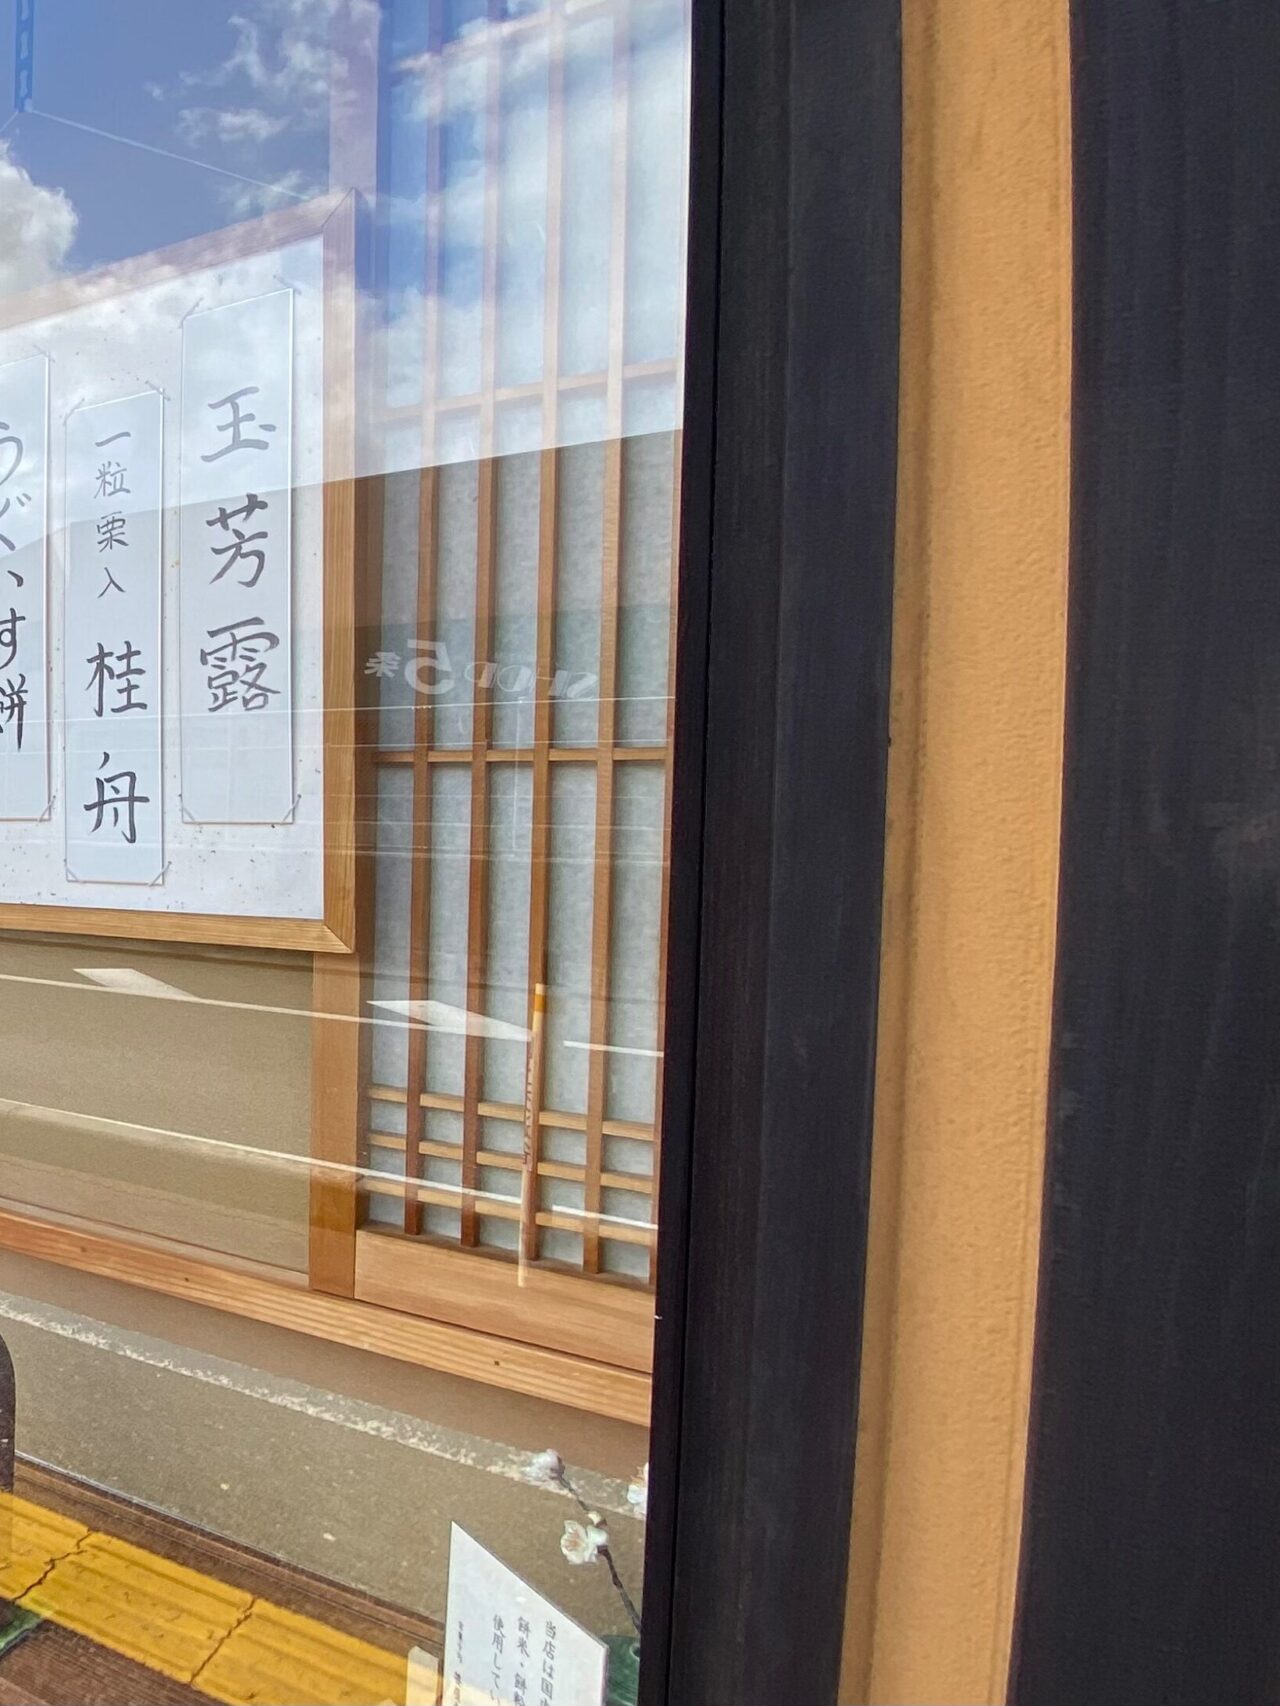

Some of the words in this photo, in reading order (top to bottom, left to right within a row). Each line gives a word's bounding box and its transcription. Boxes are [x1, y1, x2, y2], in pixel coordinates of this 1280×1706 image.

[93, 430, 132, 599] 一粒栗入
[200, 385, 282, 713] 玉芳露
[83, 640, 150, 844] 桂舟
